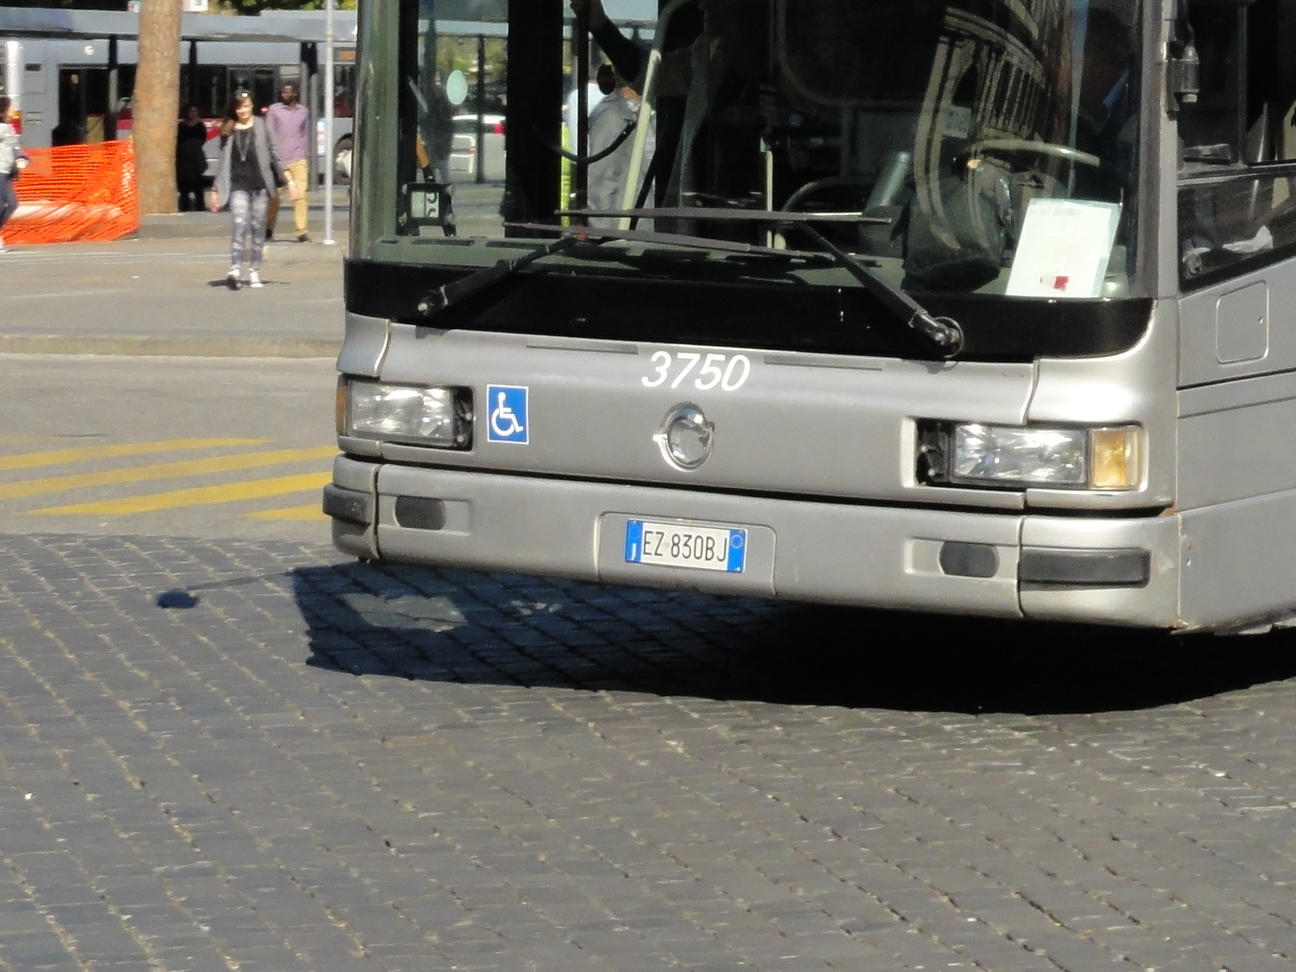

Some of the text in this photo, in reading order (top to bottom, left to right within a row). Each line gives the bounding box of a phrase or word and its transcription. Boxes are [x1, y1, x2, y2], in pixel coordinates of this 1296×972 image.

[641, 350, 751, 392] 3750
[643, 530, 665, 557] EZ
[670, 533, 728, 563] 830BJ
